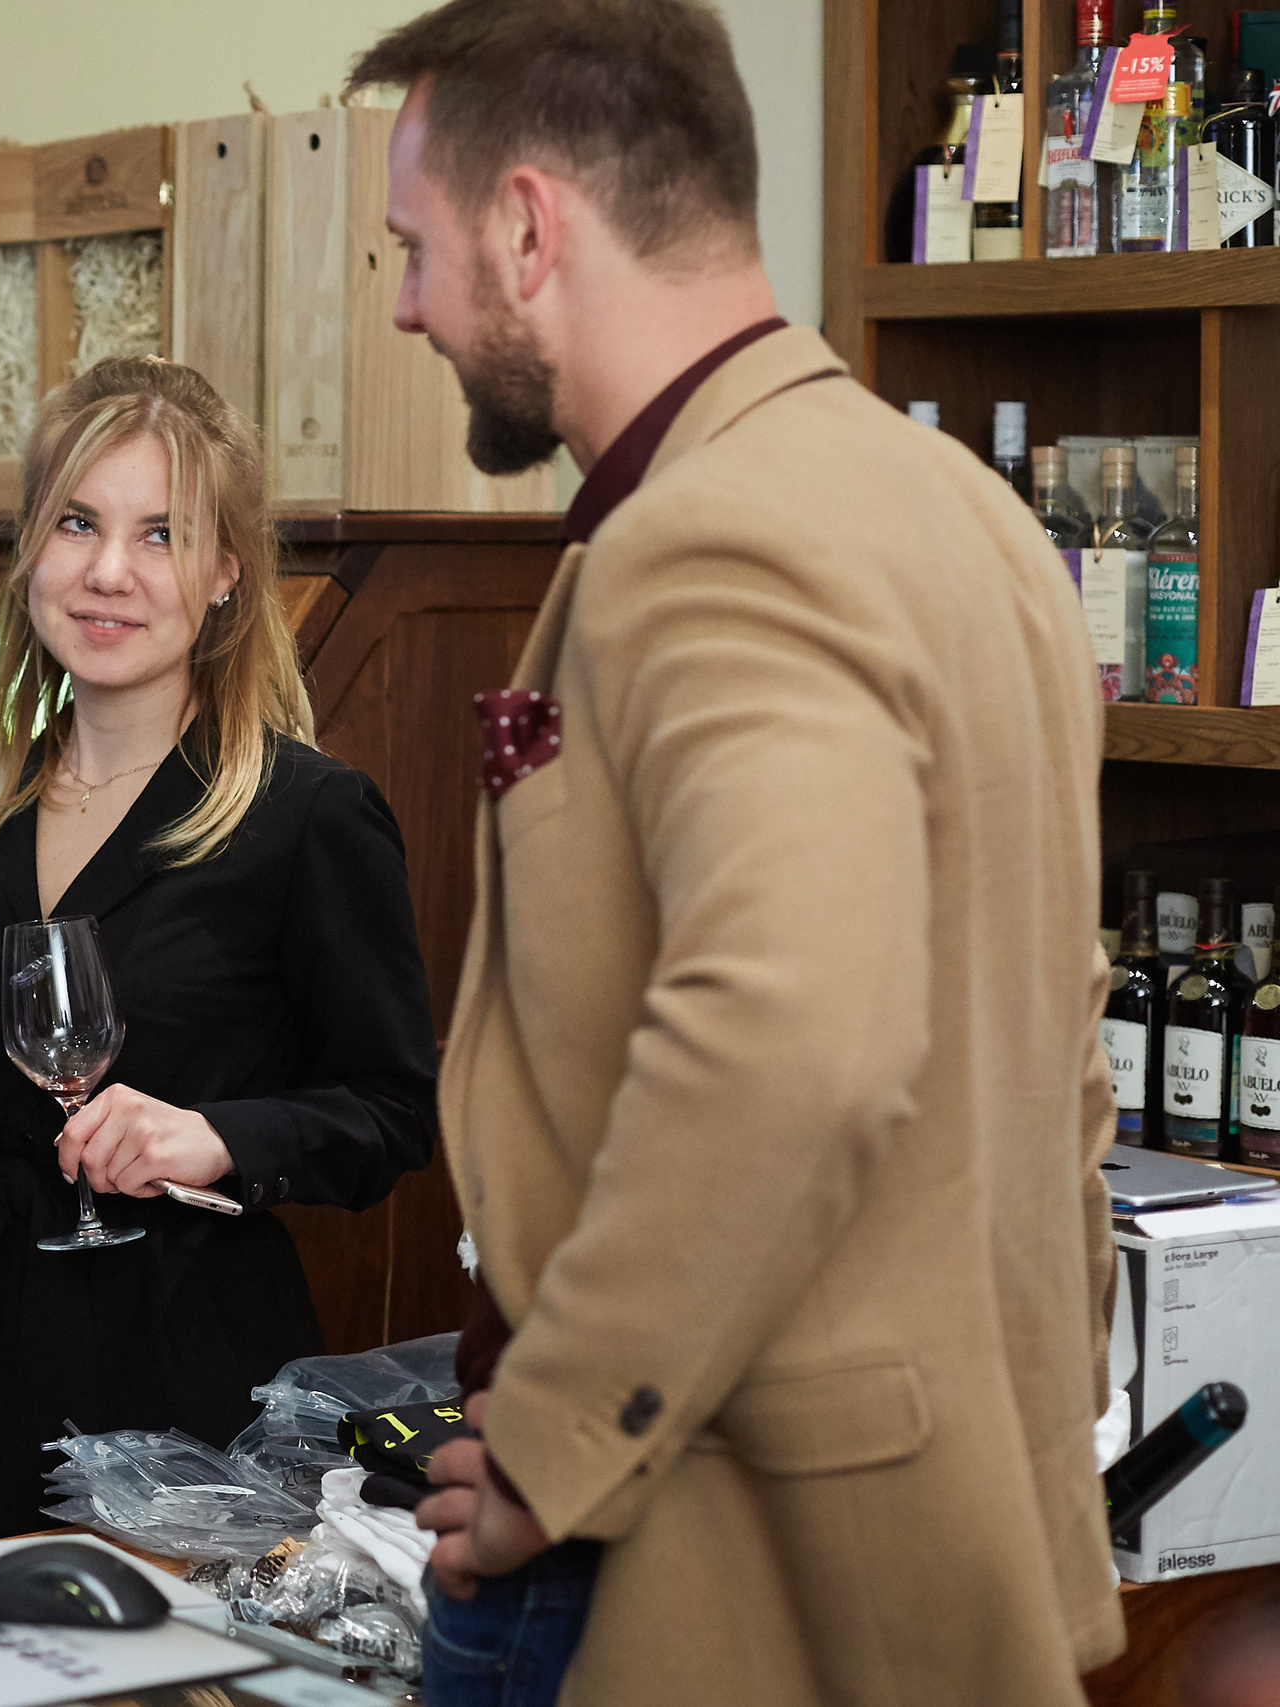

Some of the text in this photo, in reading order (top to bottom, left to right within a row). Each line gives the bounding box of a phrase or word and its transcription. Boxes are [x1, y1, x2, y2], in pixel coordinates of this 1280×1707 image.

[1121, 56, 1165, 74] -15%
[1217, 190, 1266, 204] RICK'S
[1193, 1250, 1219, 1260] Large
